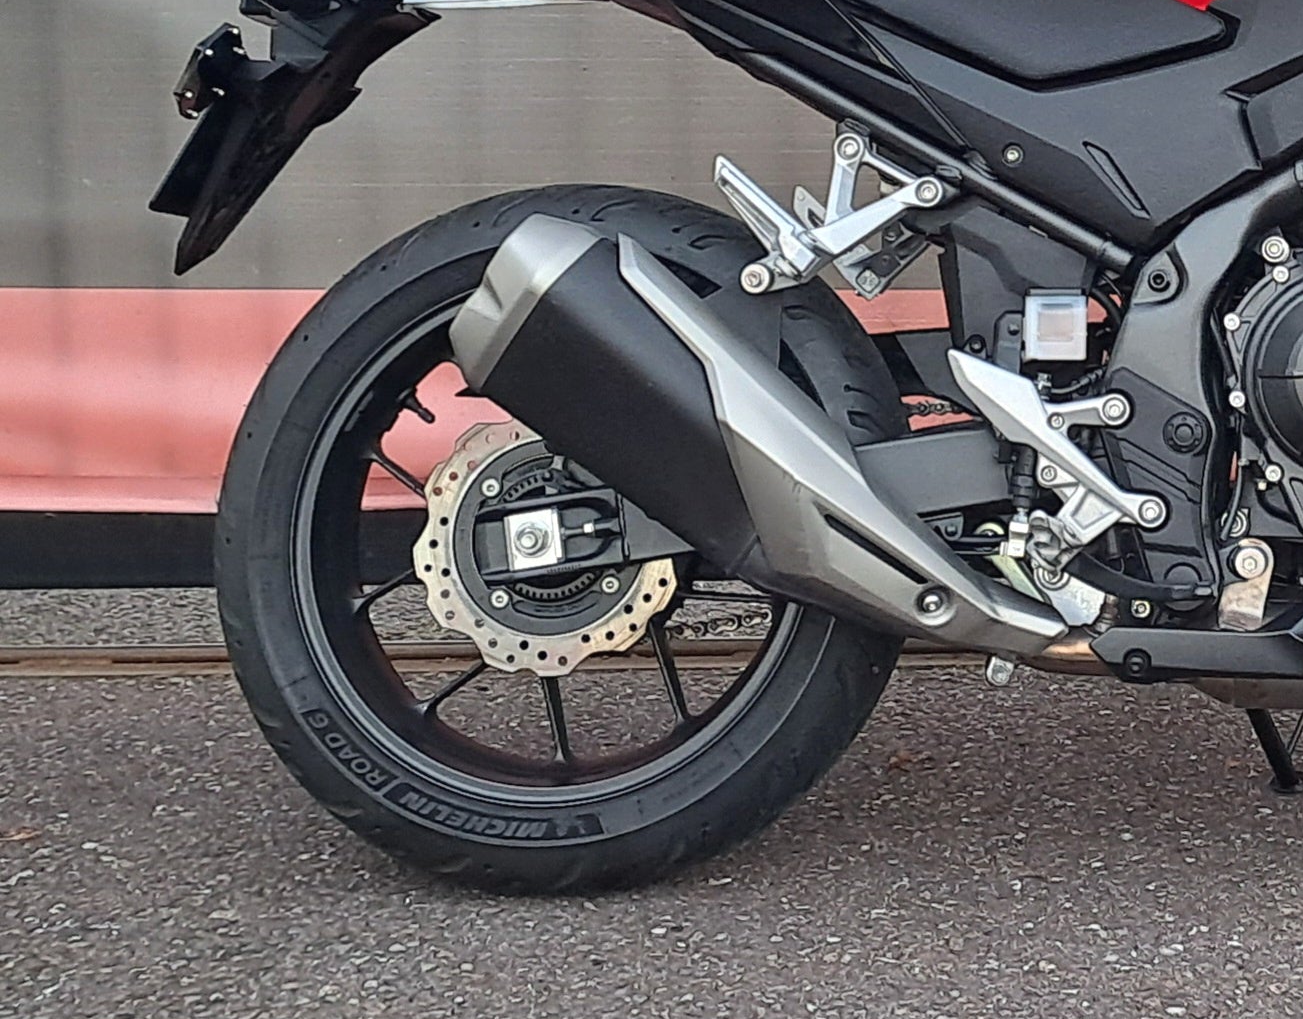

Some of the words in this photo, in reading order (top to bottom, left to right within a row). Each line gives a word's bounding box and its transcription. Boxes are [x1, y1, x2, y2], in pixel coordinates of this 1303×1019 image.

[309, 713, 329, 728] 6
[325, 733, 388, 791] ROAD
[400, 790, 549, 838] MICHELIN
